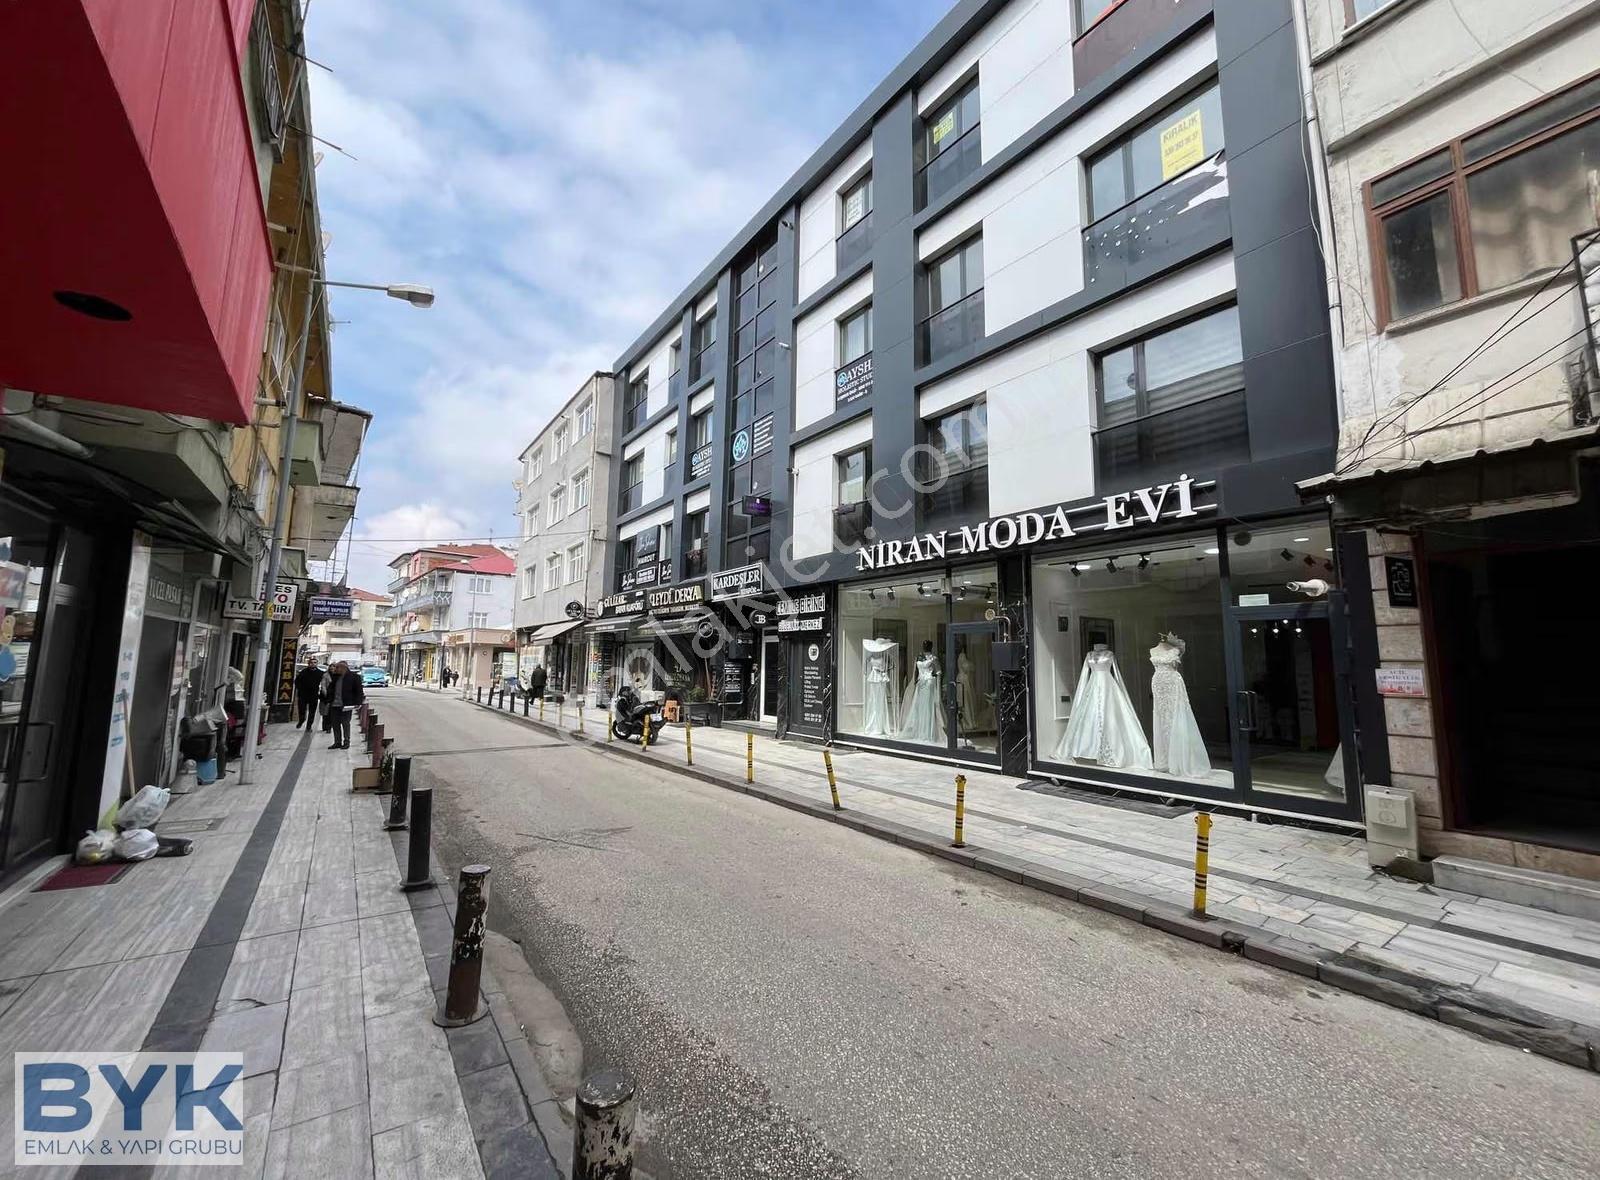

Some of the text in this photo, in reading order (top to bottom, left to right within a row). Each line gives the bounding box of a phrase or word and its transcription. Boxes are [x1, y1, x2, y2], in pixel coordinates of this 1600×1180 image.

[856, 473, 1198, 572] NİRAN MODA EVİ
[713, 568, 761, 590] KARDEŞLER
